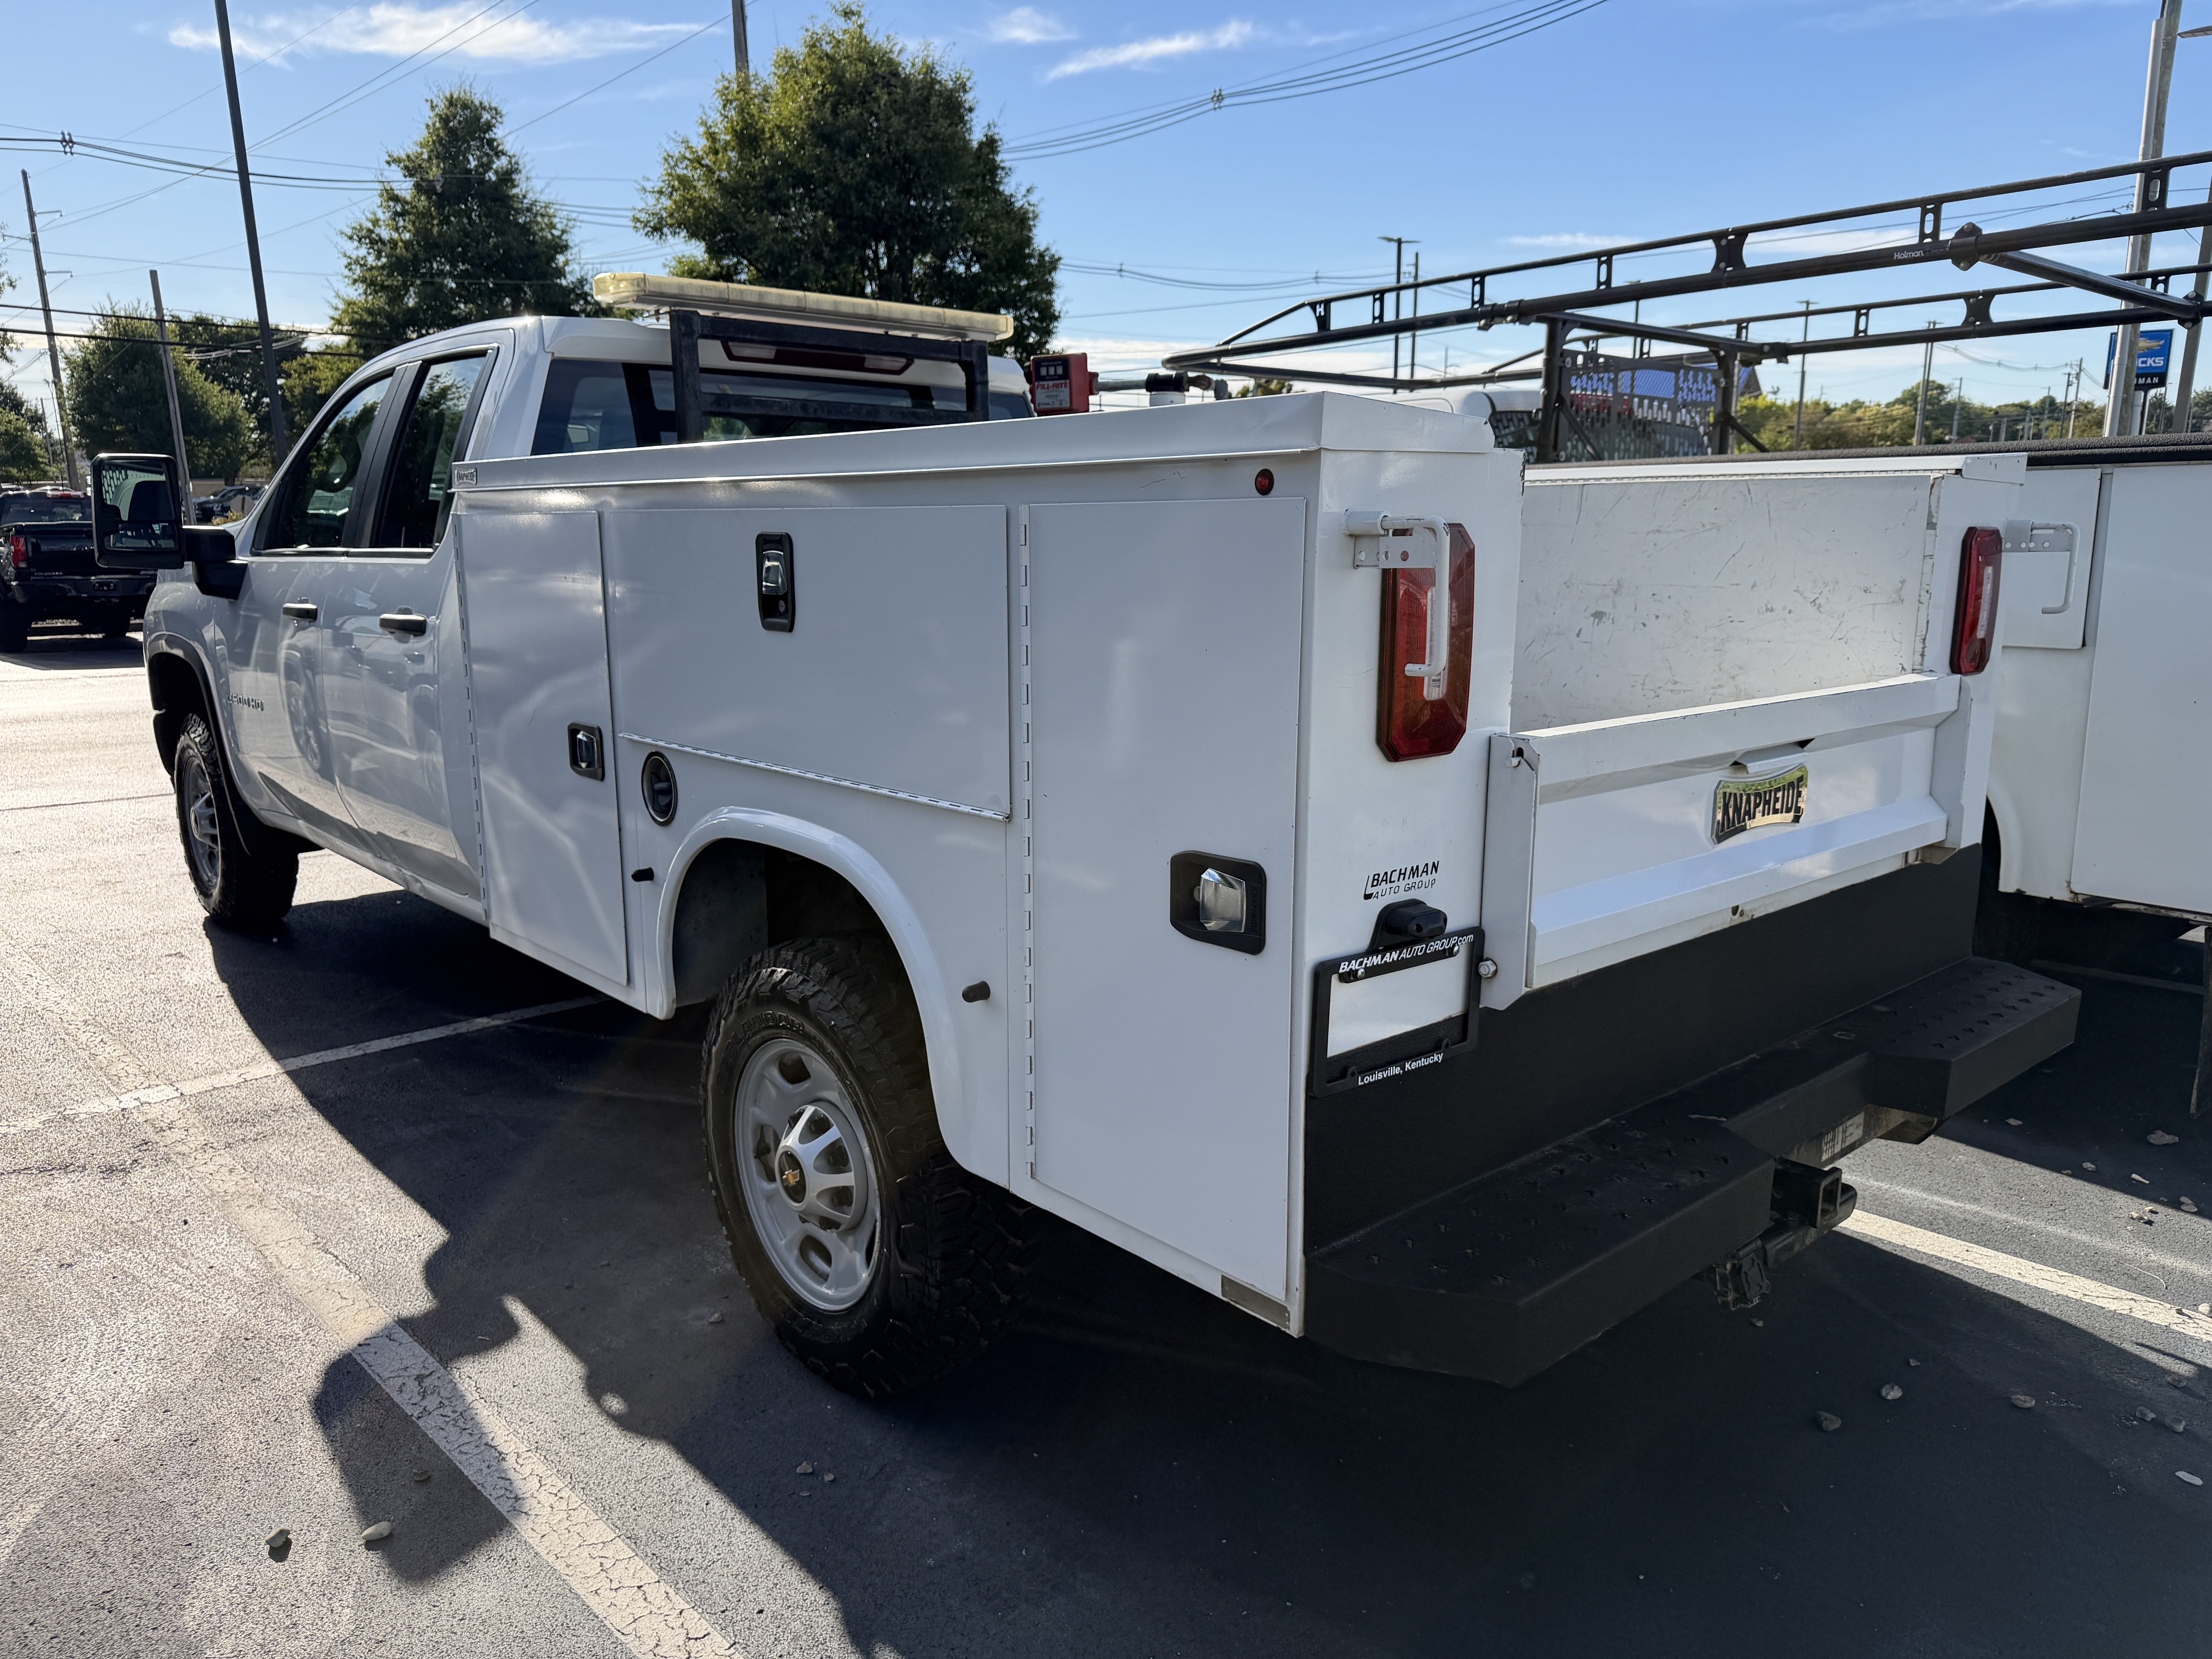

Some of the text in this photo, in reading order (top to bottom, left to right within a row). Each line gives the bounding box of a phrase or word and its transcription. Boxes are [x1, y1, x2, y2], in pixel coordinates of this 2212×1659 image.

[1894, 250, 1924, 259] Holman
[2136, 357, 2164, 367] CKS
[1037, 382, 1068, 390] FILL-RITE
[1719, 775, 1804, 834] KNAPHEIDE
[1370, 860, 1439, 888] BACHMAN
[1372, 878, 1436, 899] AUTO GROUP
[1338, 934, 1474, 973] BACHMAN AUTO GROUP.com
[1358, 1053, 1443, 1085] Louisville, Kentucky
